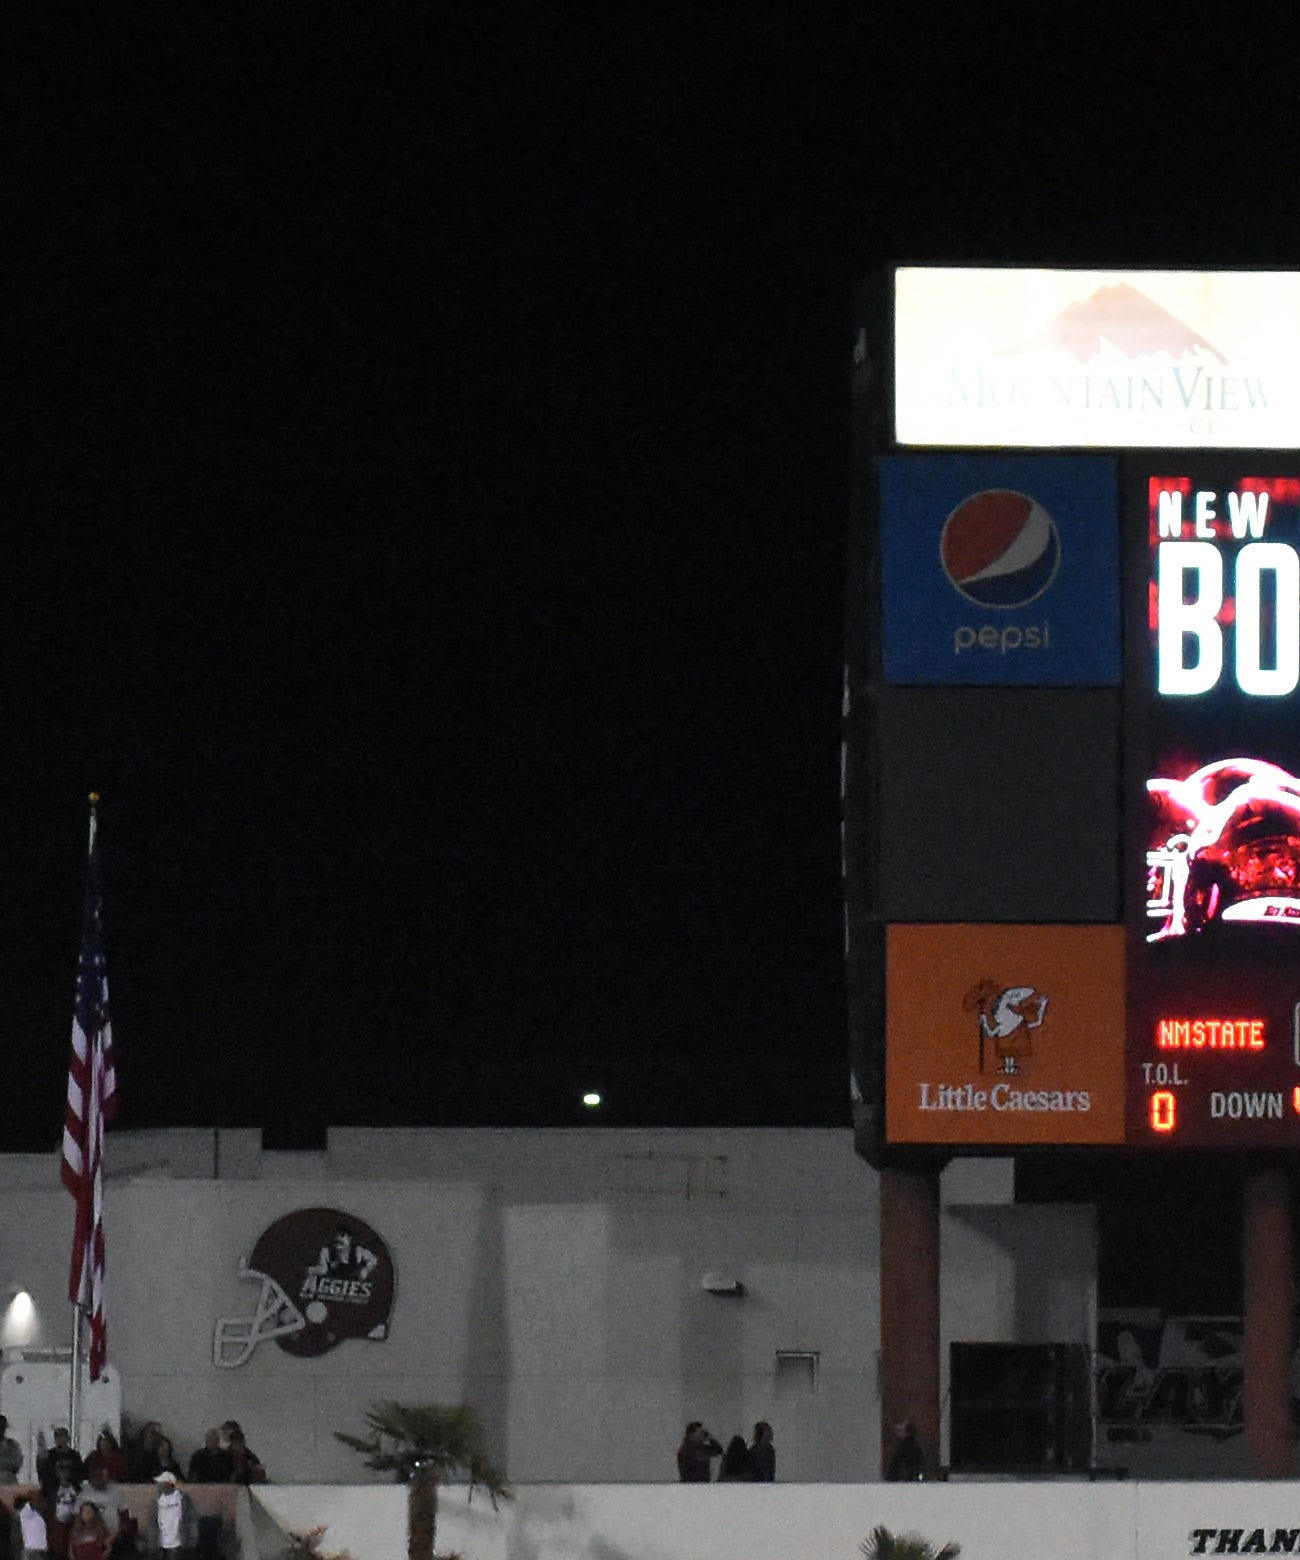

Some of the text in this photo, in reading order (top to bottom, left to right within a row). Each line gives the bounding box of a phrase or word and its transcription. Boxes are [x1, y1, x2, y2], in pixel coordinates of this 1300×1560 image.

[1158, 491, 1270, 539] NEW
[953, 620, 1051, 656] pepsi
[1158, 1020, 1265, 1050] NMSTATE
[1142, 1063, 1189, 1086] T.O.L.
[918, 1083, 1091, 1112] Little Caesars
[1150, 1091, 1175, 1133] 0
[1210, 1094, 1283, 1119] DOWN
[299, 1274, 373, 1298] AGGIES
